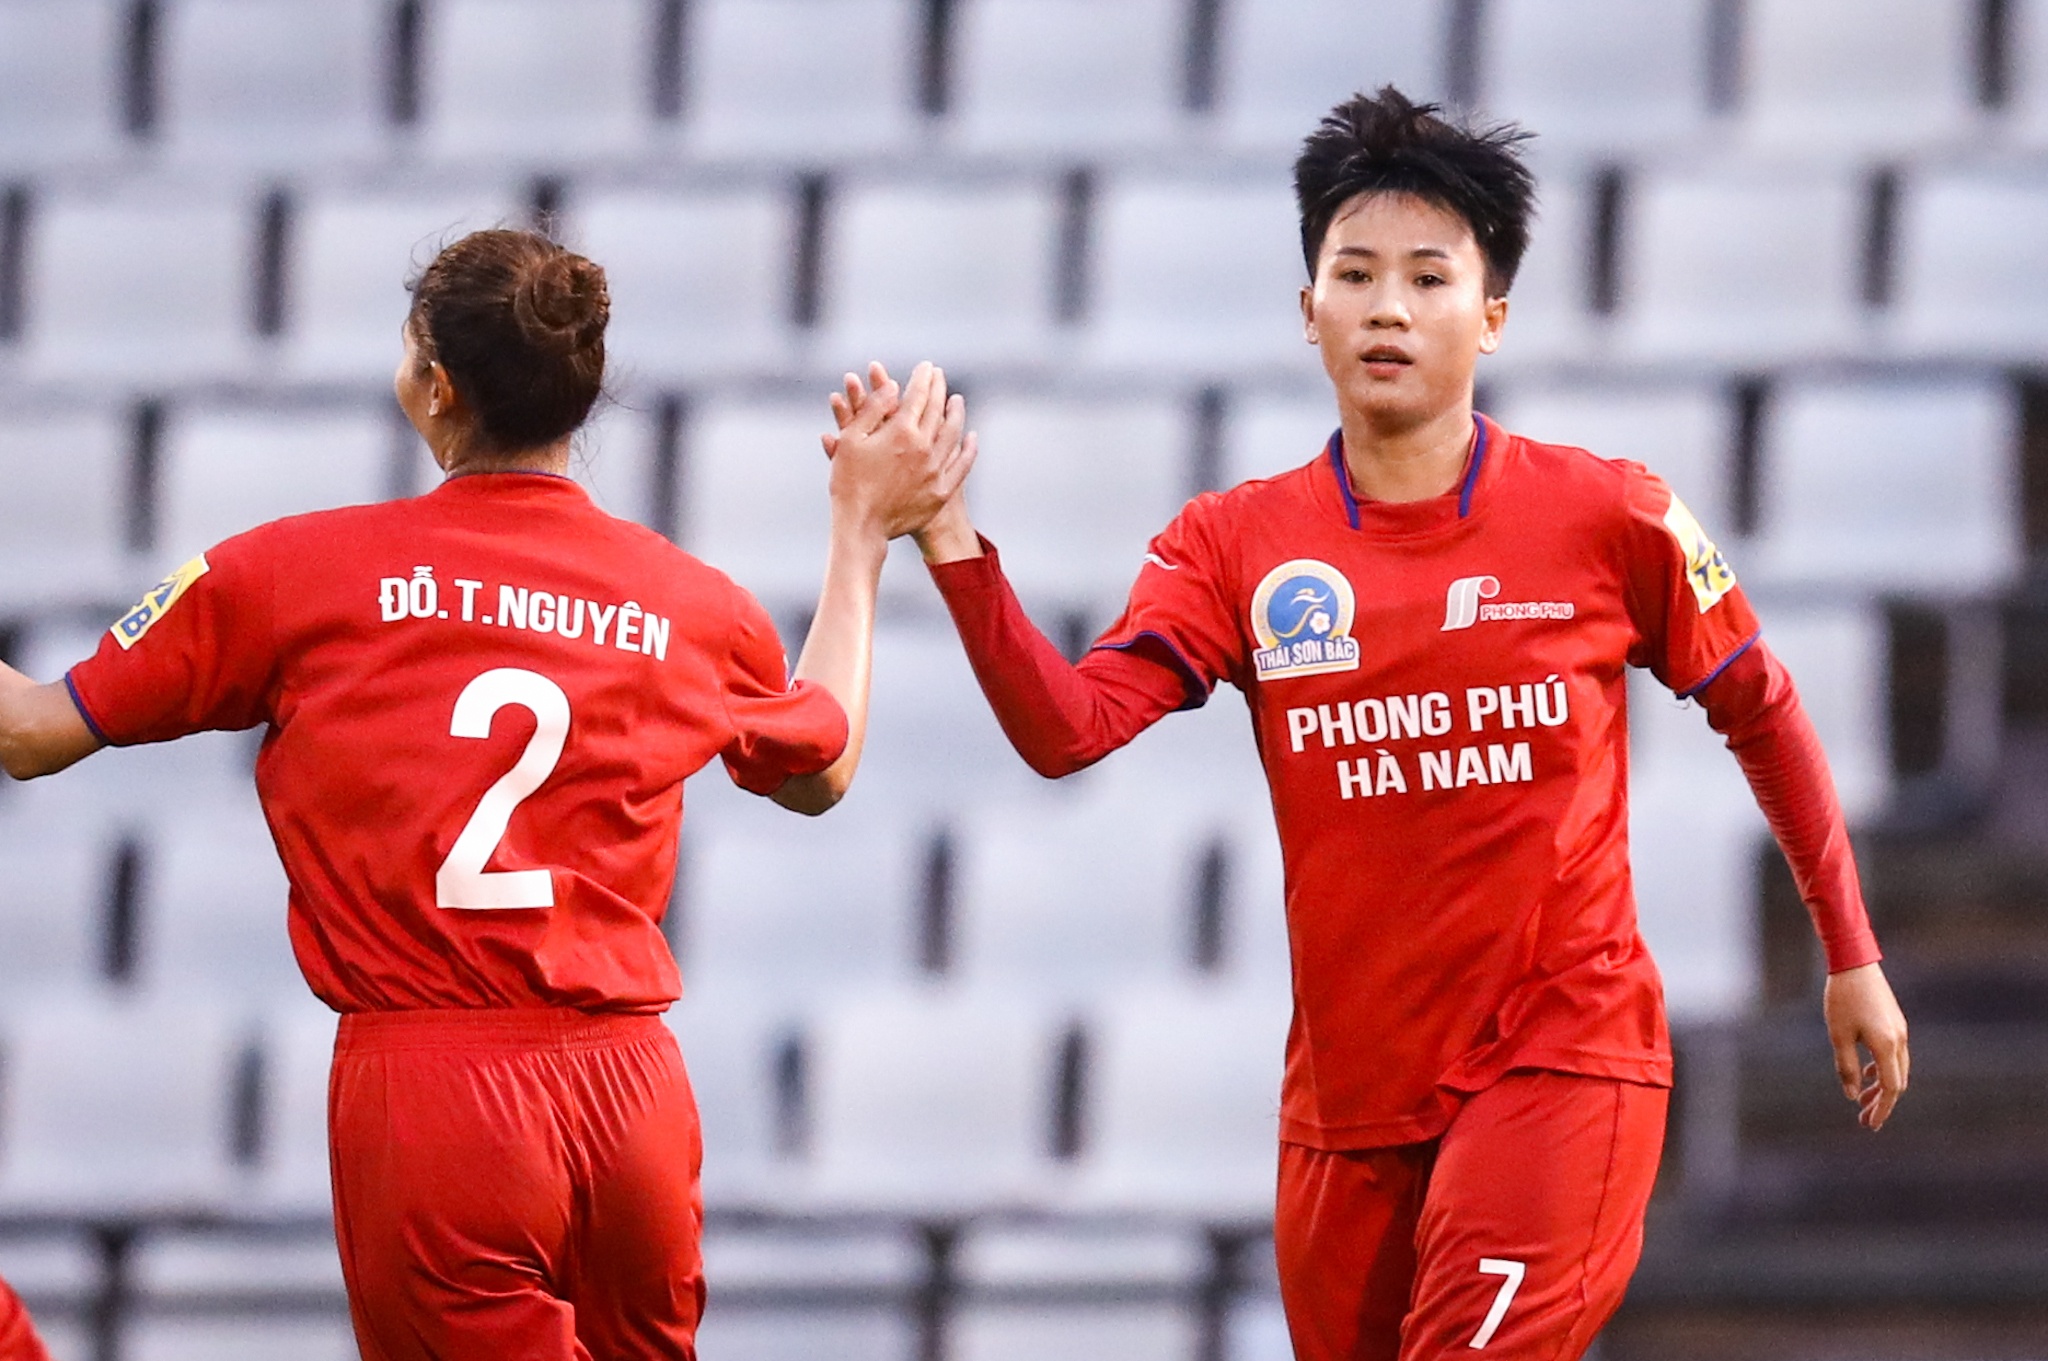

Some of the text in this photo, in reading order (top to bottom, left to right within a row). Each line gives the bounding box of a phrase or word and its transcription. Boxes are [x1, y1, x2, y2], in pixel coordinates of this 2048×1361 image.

[1481, 602, 1574, 620] PHONG PHU
[1258, 645, 1290, 669] THÁI
[1292, 639, 1322, 665] SƠN
[1287, 674, 1568, 753] PHONG PHÚ
[437, 668, 570, 909] 2
[1337, 743, 1533, 799] HÀ NAM
[1469, 1259, 1526, 1350] 7
